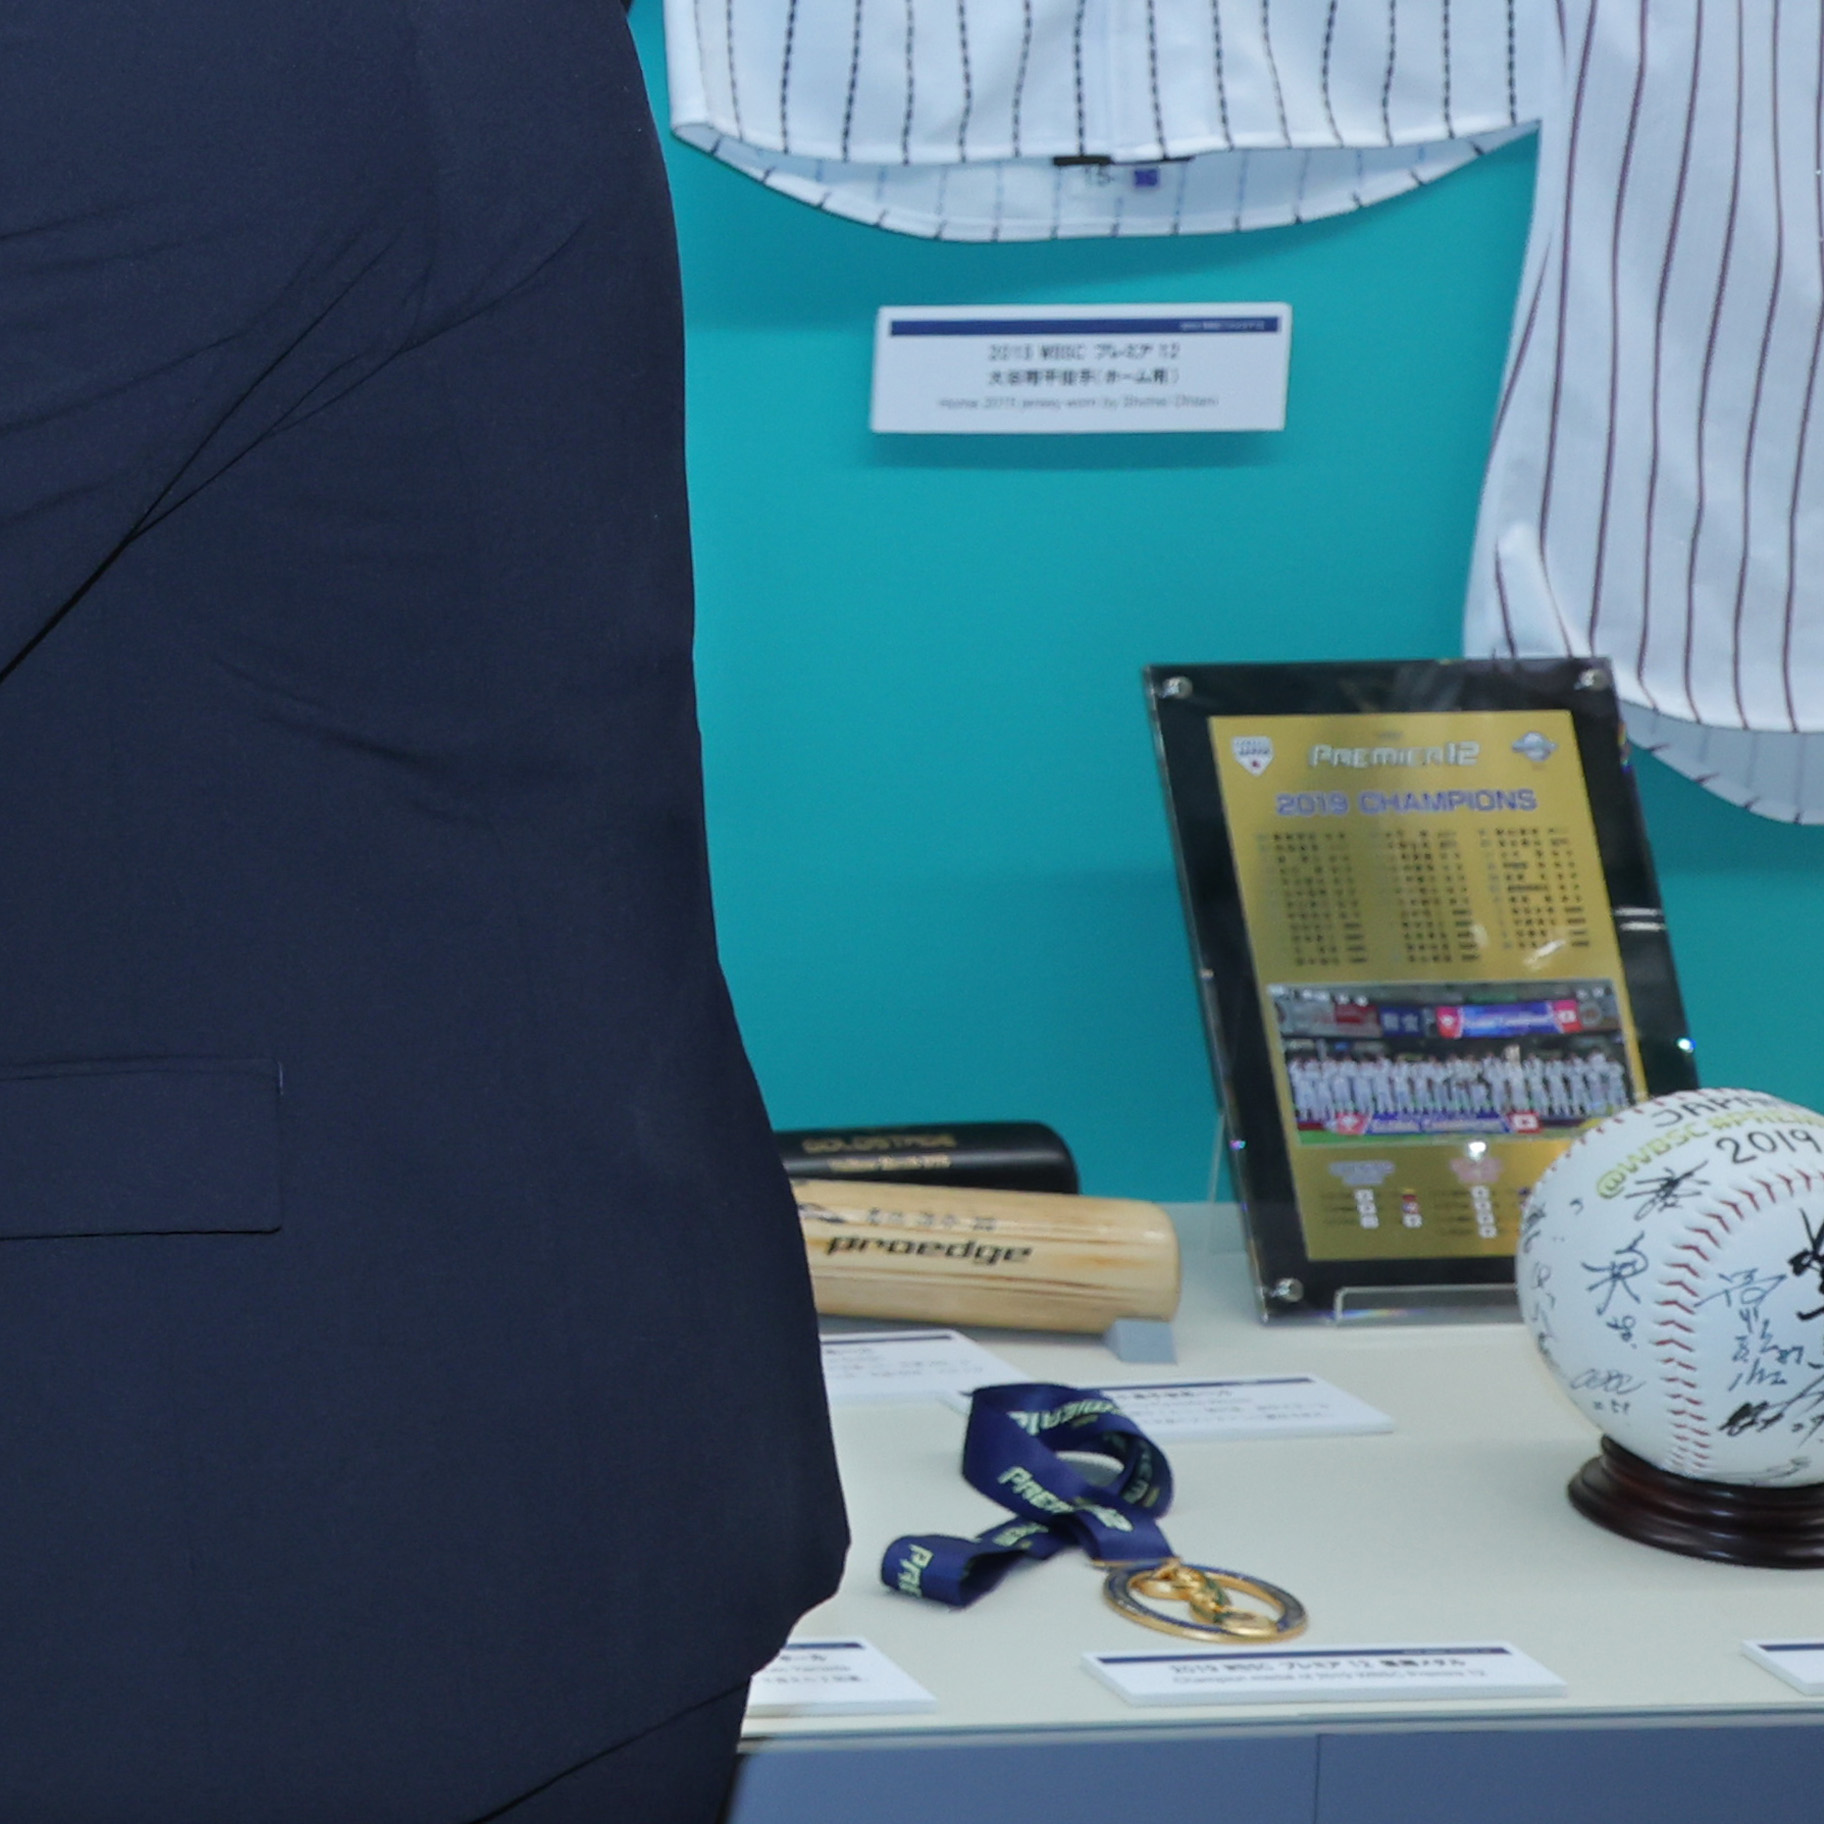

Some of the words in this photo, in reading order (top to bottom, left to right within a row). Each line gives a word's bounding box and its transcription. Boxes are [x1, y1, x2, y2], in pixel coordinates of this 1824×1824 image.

[1357, 788, 1538, 815] CHAMPIONS
[1715, 1129, 1823, 1165] 2019
[824, 1235, 1033, 1265] proedge
